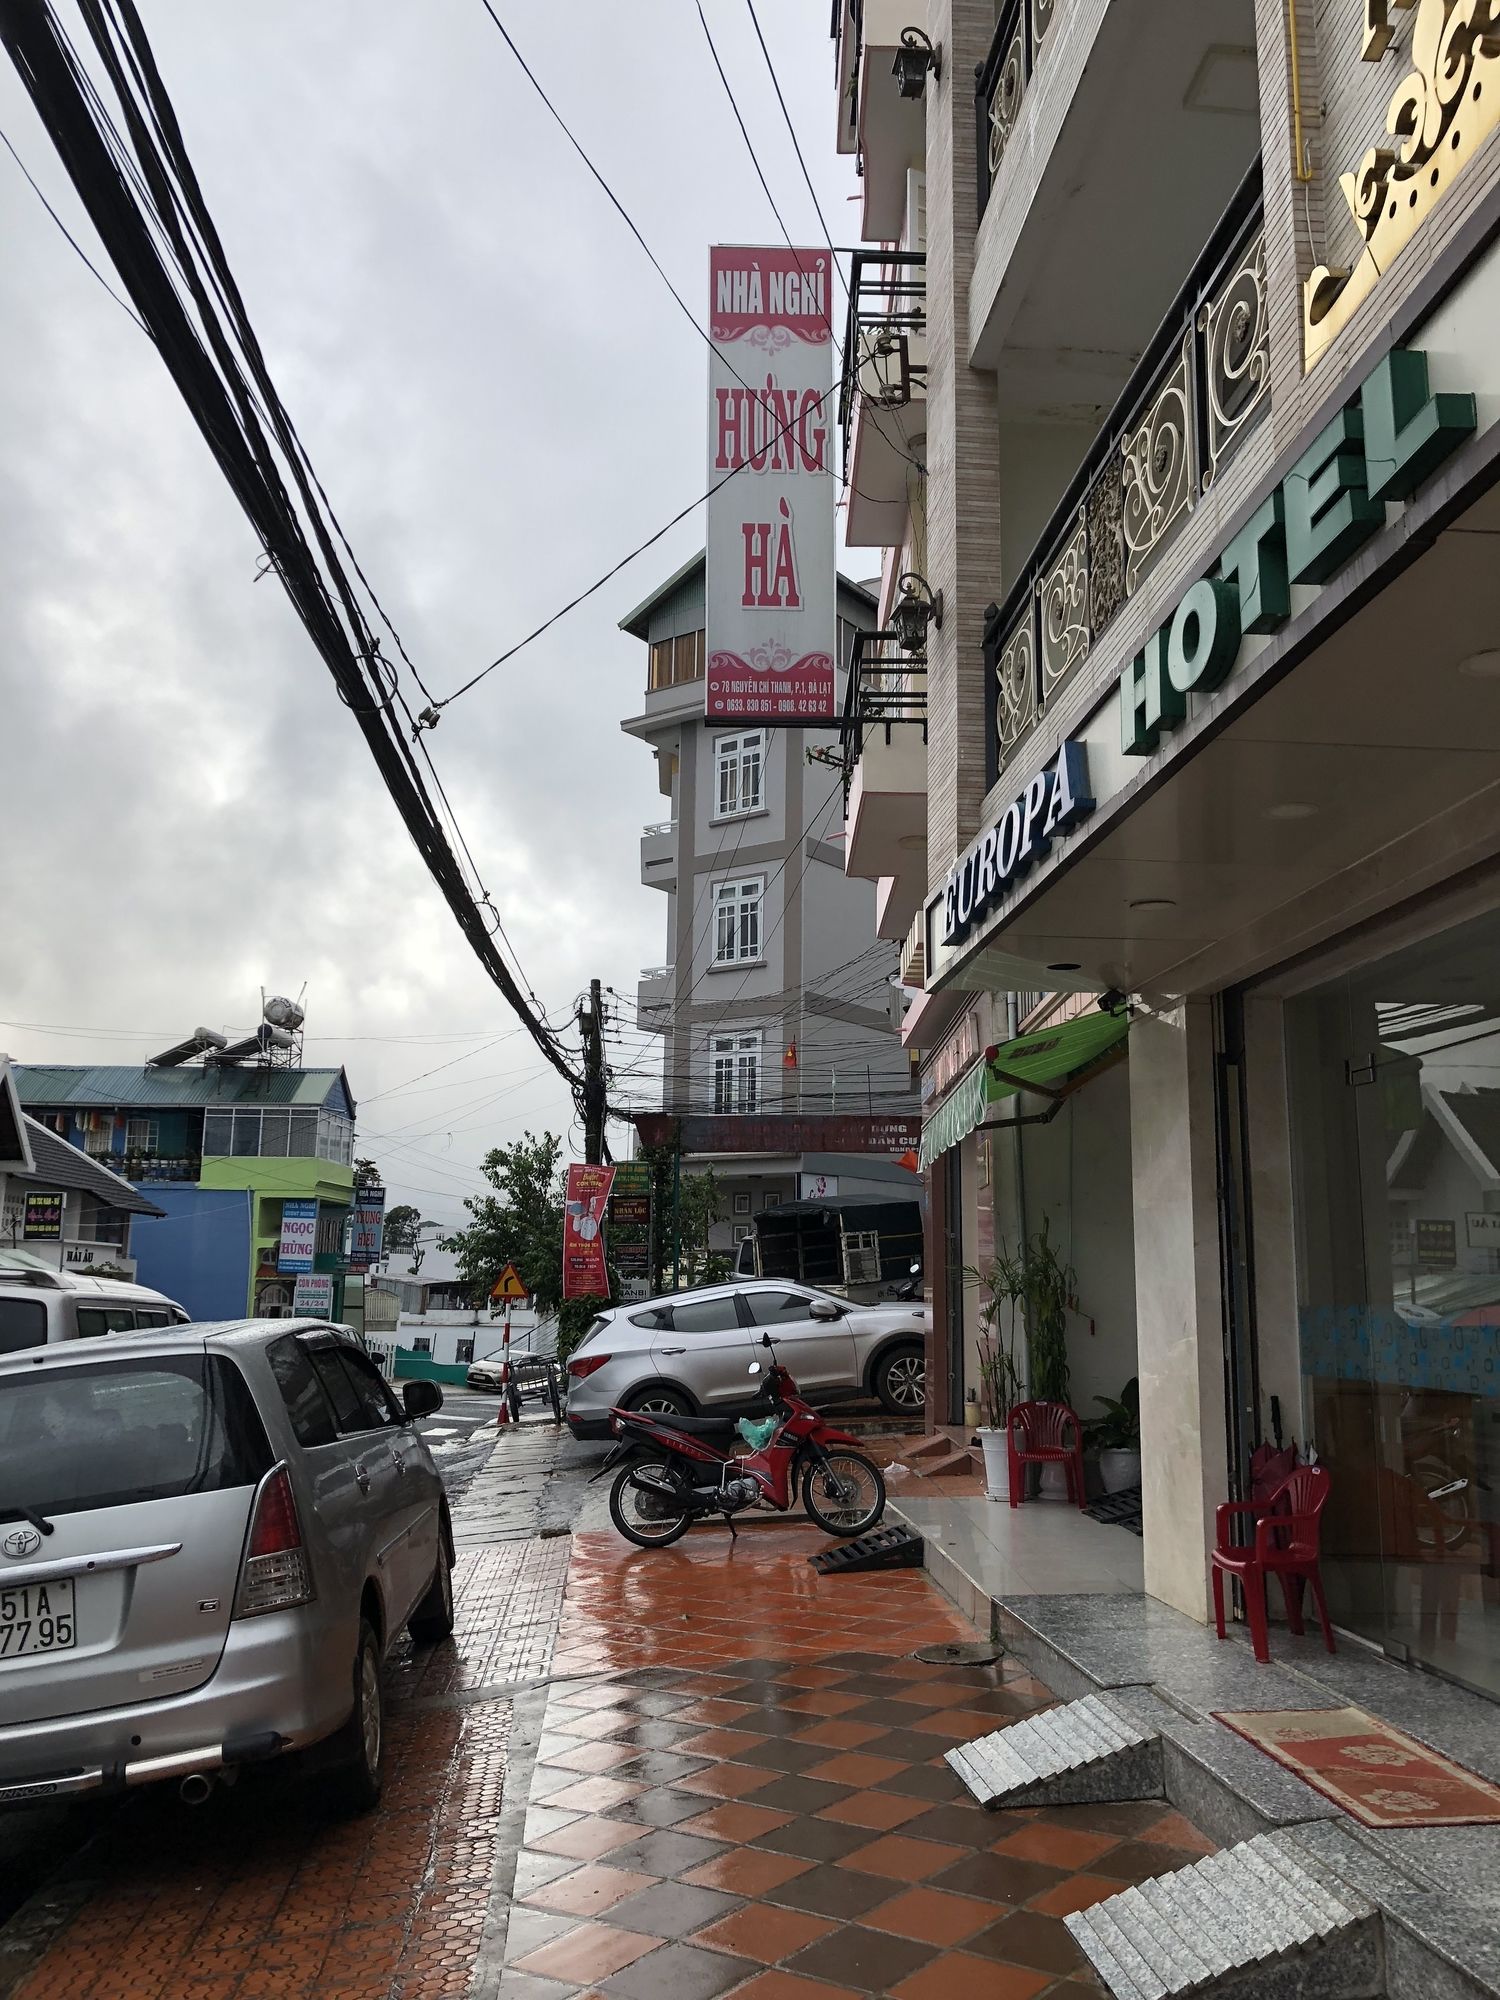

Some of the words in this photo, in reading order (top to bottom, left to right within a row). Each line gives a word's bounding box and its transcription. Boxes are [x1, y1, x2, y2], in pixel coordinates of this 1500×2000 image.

[717, 262, 764, 314] NHÀ
[770, 258, 825, 315] NGHỈ
[715, 373, 826, 473] HƯNG
[742, 496, 800, 607] HÀ
[941, 740, 1096, 946] EUROPA
[1120, 348, 1476, 756] HOTEL
[722, 681, 730, 692] 78
[731, 676, 757, 693] NGUYỄN
[758, 679, 769, 693] CHÍ
[808, 679, 817, 694] ĐÀ
[819, 682, 831, 697] LẠT
[760, 700, 772, 712] 851
[799, 700, 806, 712] 42
[818, 700, 826, 712] 42
[356, 1210, 381, 1224] TRUNG
[283, 1222, 313, 1236] NGỌC
[67, 1247, 82, 1262] HẢI
[281, 1240, 312, 1255] HÙNG
[2, 1586, 51, 1621] 51A
